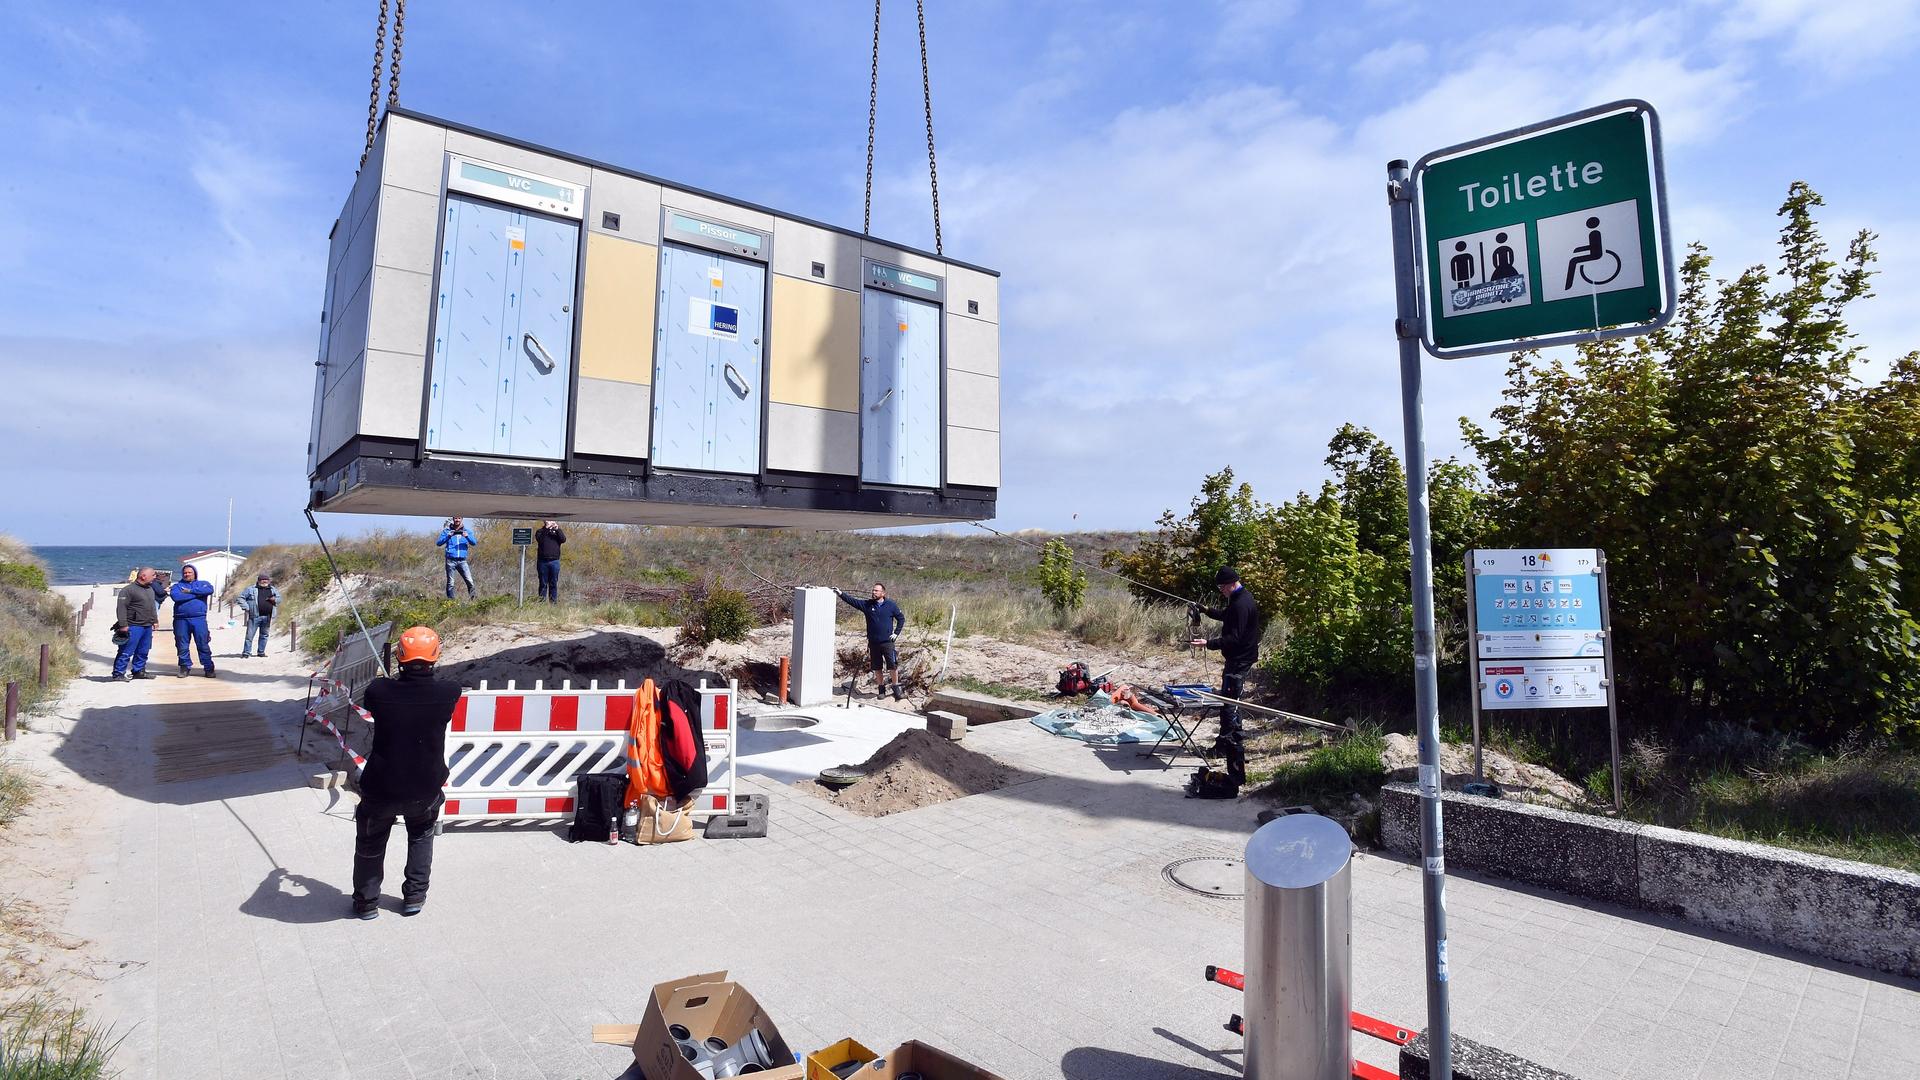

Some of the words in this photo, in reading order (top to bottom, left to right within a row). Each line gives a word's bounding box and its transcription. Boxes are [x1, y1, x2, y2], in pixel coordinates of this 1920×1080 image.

[508, 176, 532, 191] WC
[1458, 161, 1604, 212] Toilette
[699, 223, 737, 240] Pissoir
[897, 272, 913, 283] WC
[714, 321, 737, 331] HERING
[1521, 555, 1536, 566] 18
